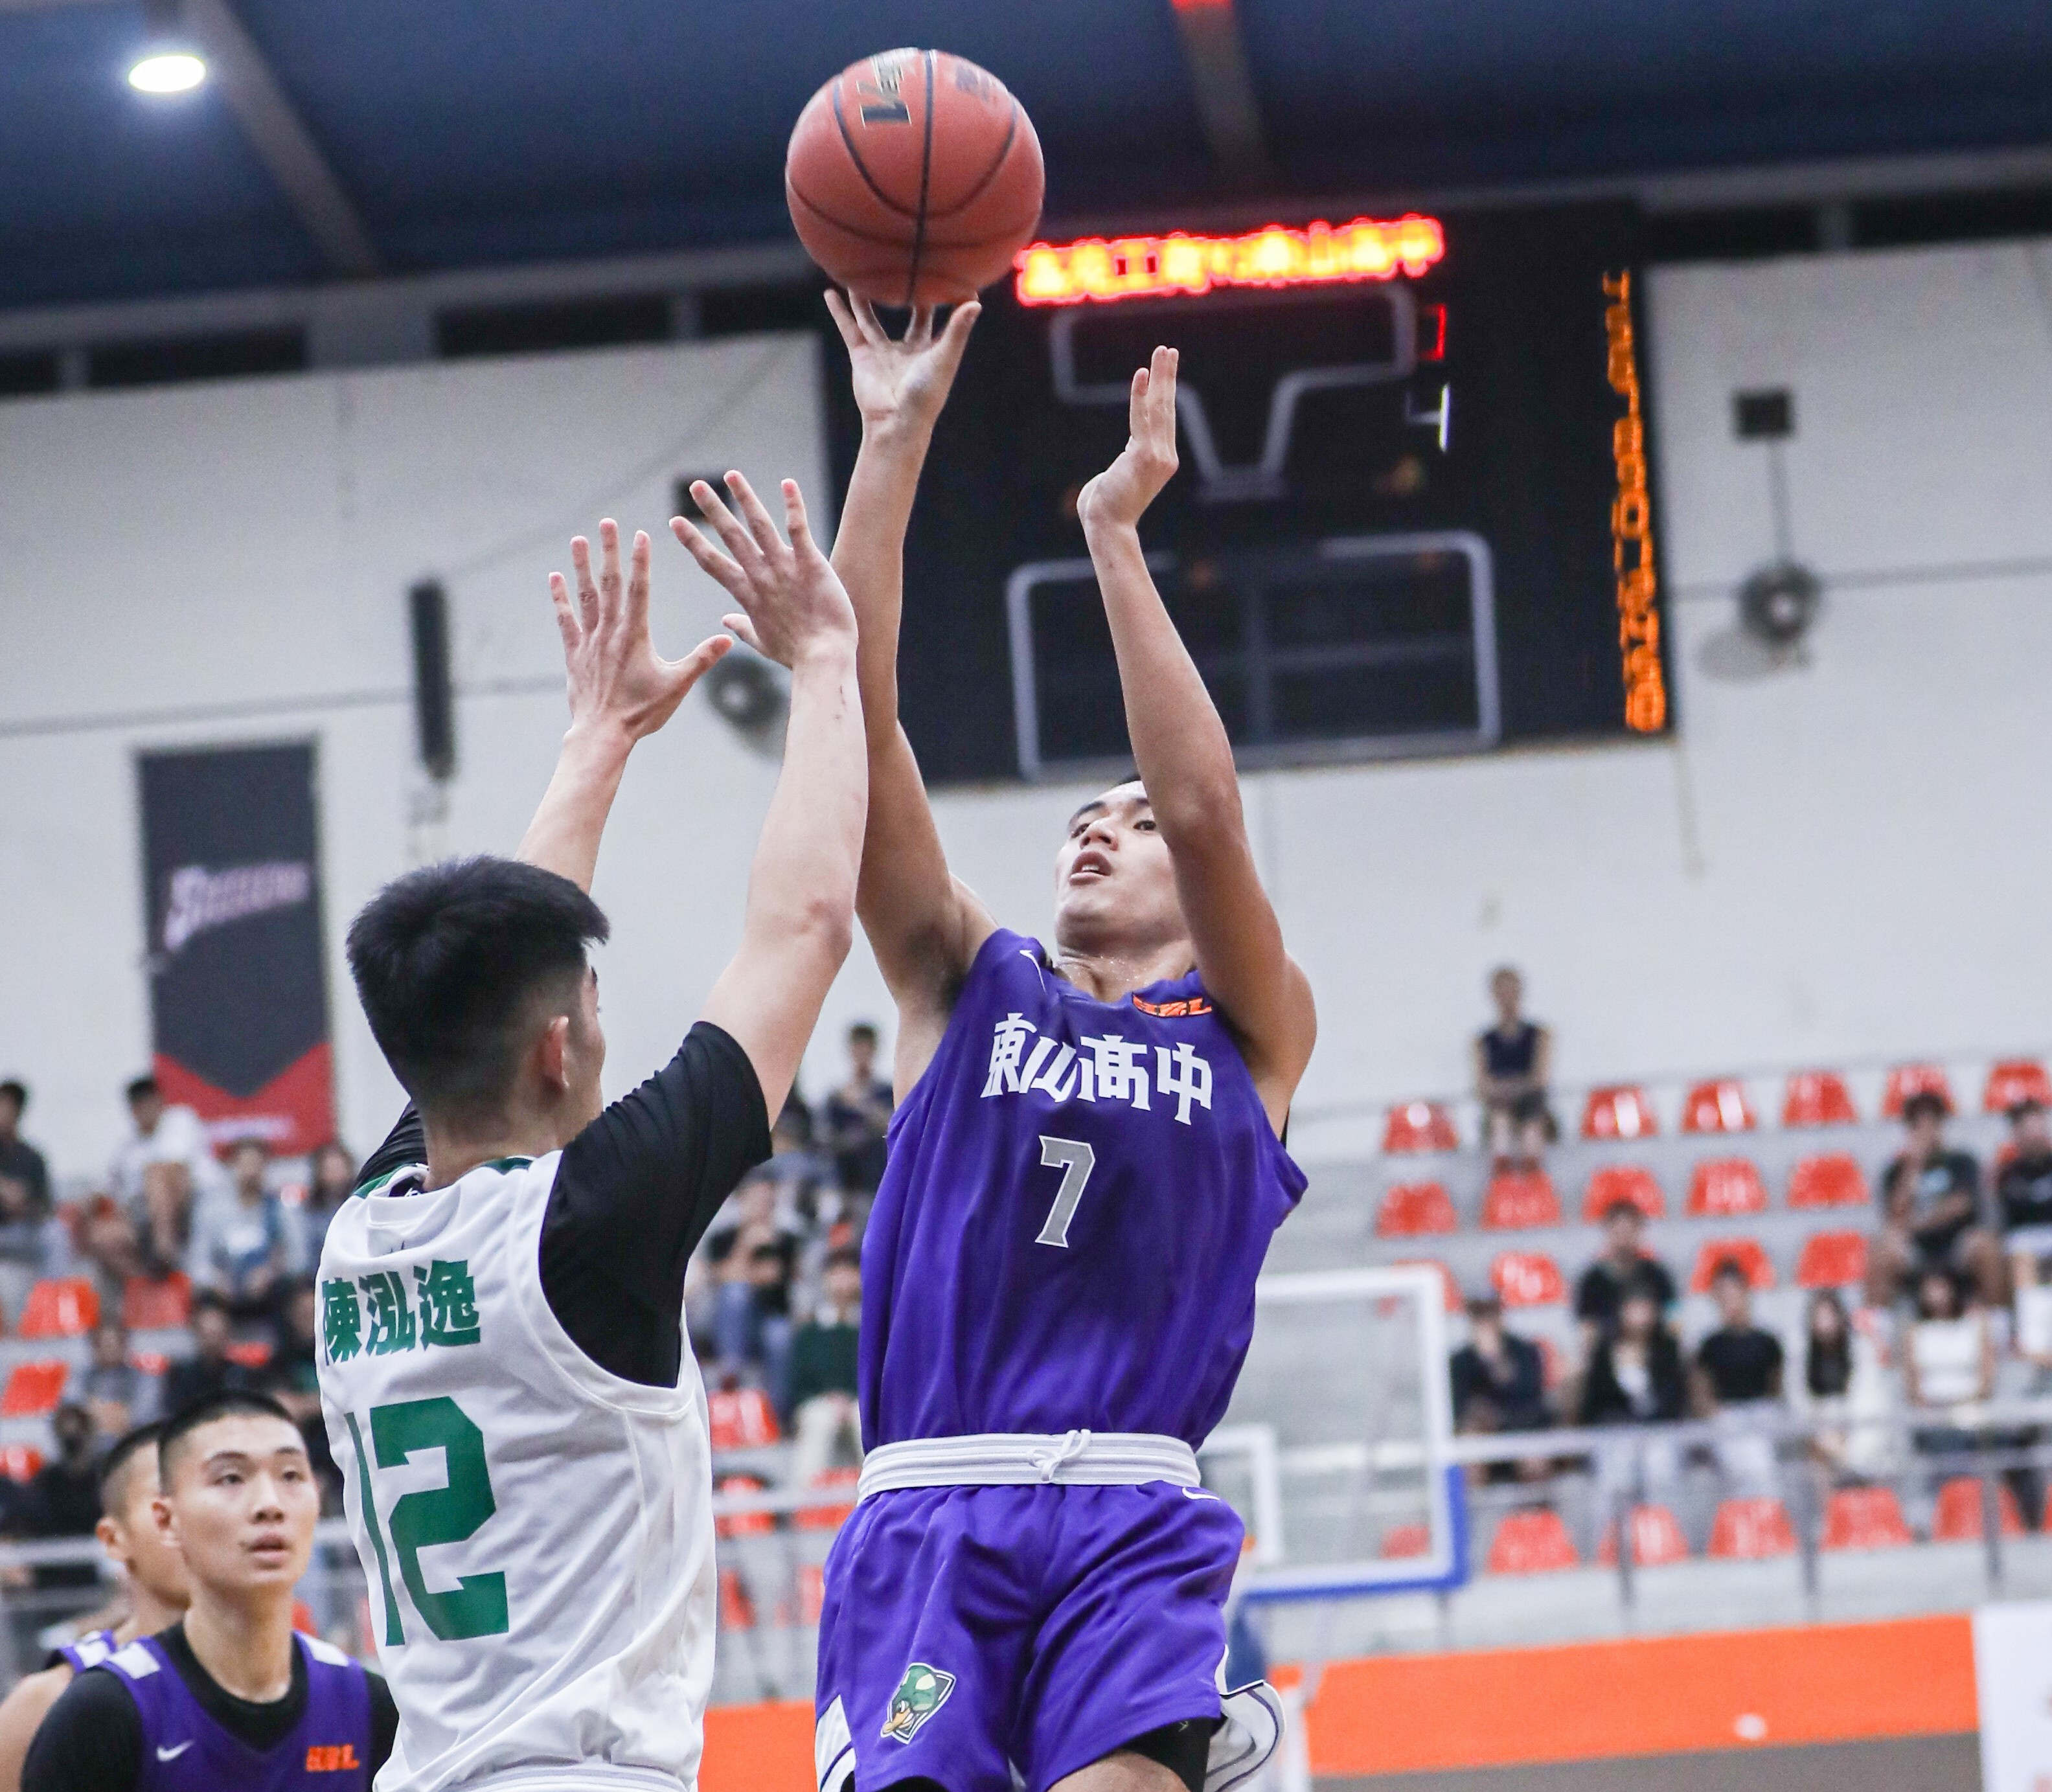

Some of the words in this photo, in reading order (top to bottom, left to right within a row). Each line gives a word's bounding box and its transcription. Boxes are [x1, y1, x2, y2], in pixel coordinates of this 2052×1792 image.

[980, 1012, 1213, 1126] 東山高中
[1034, 1135, 1095, 1249] 7
[322, 1260, 481, 1366] 陳泓逸
[345, 1396, 509, 1646] 12
